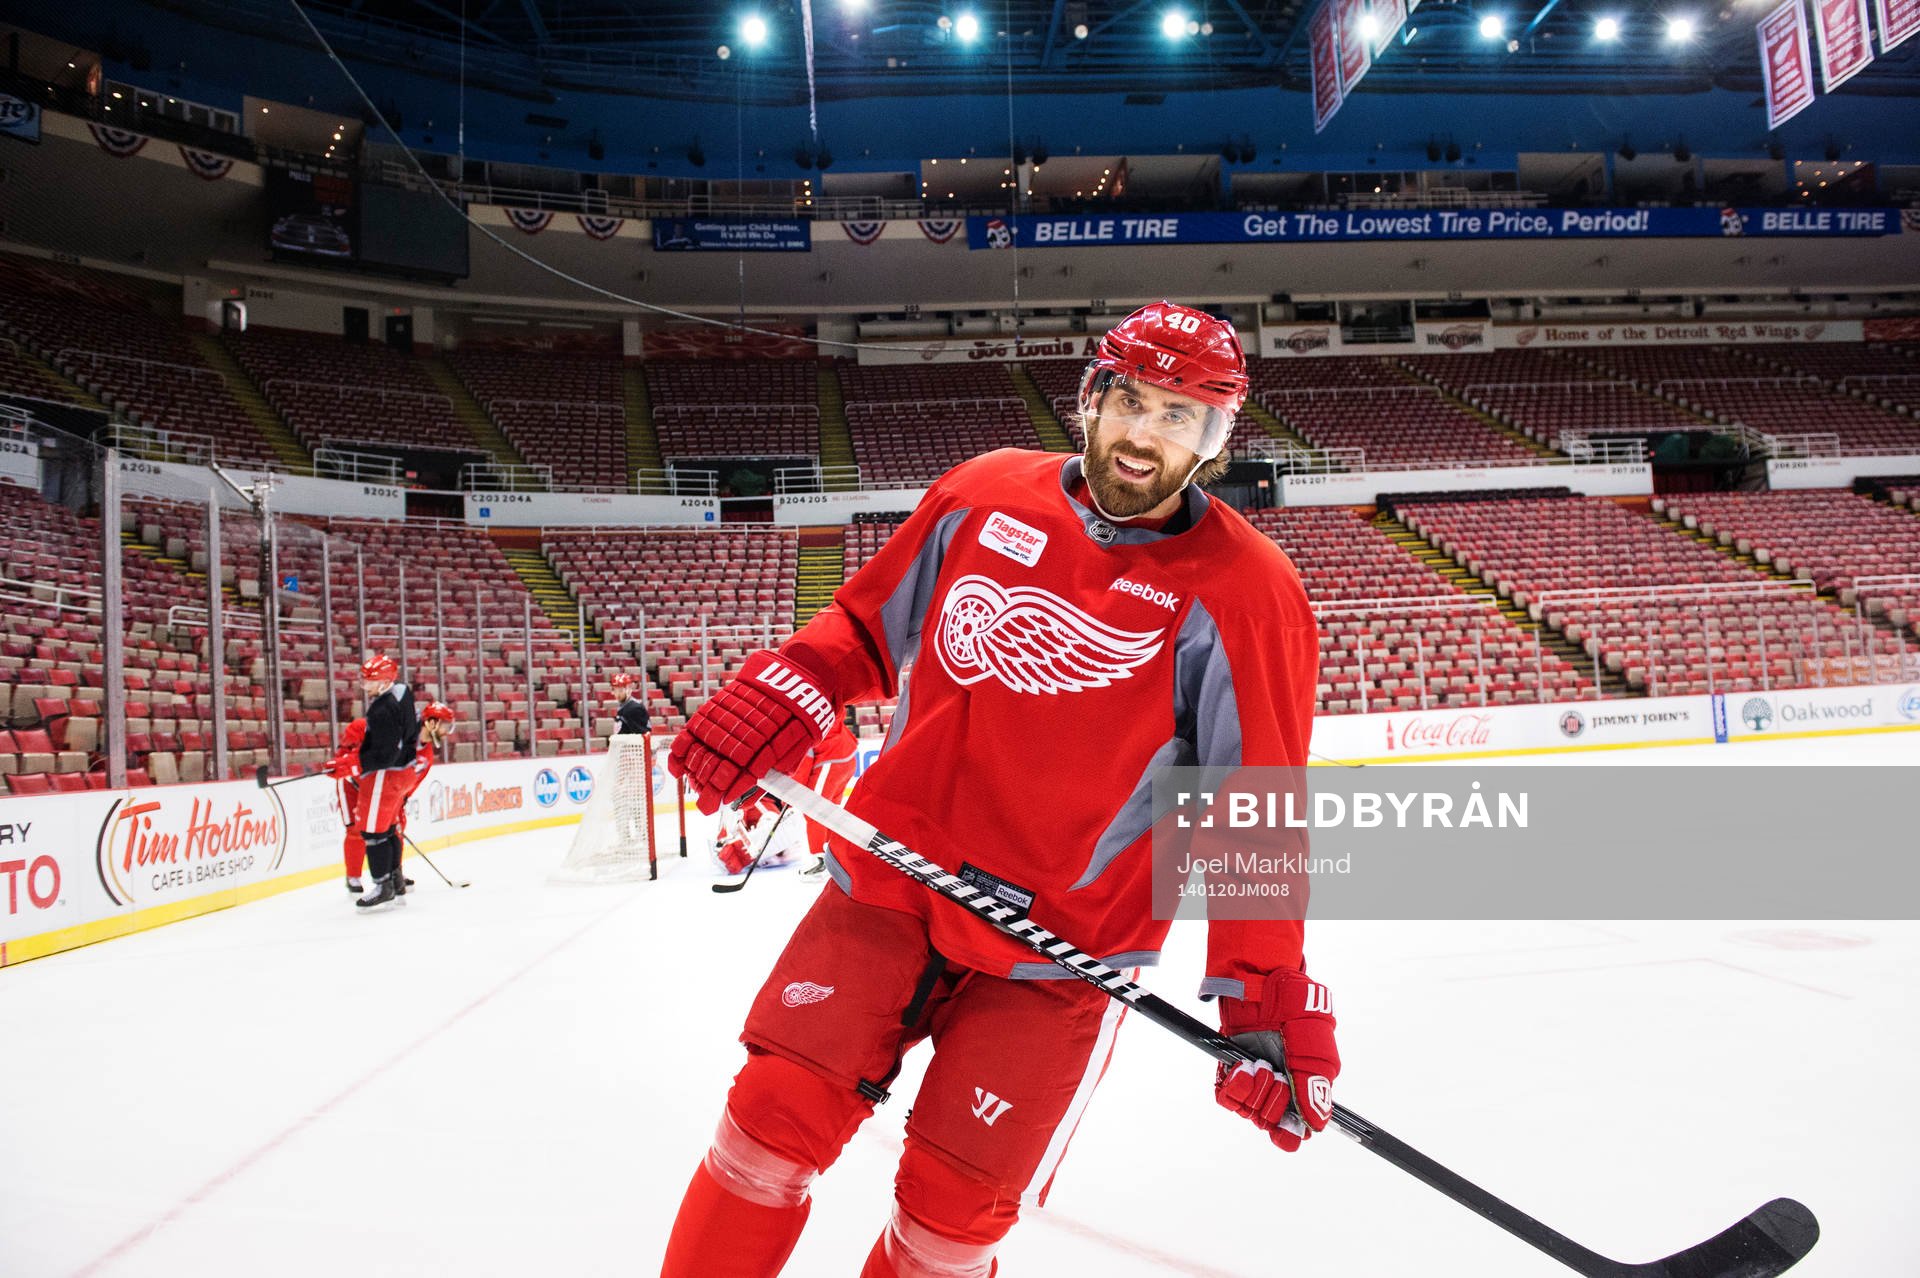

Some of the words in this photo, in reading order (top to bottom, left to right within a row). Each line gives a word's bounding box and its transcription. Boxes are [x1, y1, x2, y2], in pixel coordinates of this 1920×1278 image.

[694, 223, 726, 233] Getting
[728, 224, 748, 232] your
[749, 223, 771, 231] Child
[1035, 220, 1114, 241] BELLE
[1122, 218, 1179, 239] TIRE
[1243, 214, 1287, 236] Get
[1295, 214, 1339, 235] The
[1346, 213, 1432, 234] Lowest
[1439, 212, 1482, 233] Tire
[1488, 211, 1554, 235] Price,
[1562, 211, 1649, 232] Period!
[1762, 212, 1830, 231] BELLE
[1837, 212, 1886, 230] TIRE
[1164, 311, 1201, 334] 40
[1545, 328, 1589, 342] Home
[1598, 328, 1615, 339] of
[1622, 327, 1647, 340] the
[1655, 326, 1710, 340] Detroit
[1716, 326, 1747, 340] Red
[1754, 325, 1801, 341] Wings
[968, 341, 1007, 359] Joe
[1015, 338, 1074, 358] Louis
[1289, 477, 1307, 485] 206
[1309, 476, 1327, 485] 207
[364, 486, 399, 498] B203C
[808, 495, 828, 503] 205
[680, 499, 715, 507] A204B
[991, 517, 1042, 545] Flagstar
[1015, 542, 1033, 554] Bank
[1108, 577, 1181, 613] Reebok
[1591, 711, 1639, 728] JIMMY
[1643, 710, 1691, 725] JOHN'S
[1780, 698, 1873, 721] Oakwood
[445, 784, 473, 819] Little
[475, 783, 523, 815] Caesars
[119, 801, 179, 874] Tim
[184, 796, 278, 862] Hortons
[151, 869, 184, 891] CAFE
[187, 871, 193, 884] &
[196, 861, 225, 882] BAKE
[229, 855, 254, 876] SHOP
[998, 887, 1029, 906] Reebok
[877, 841, 1152, 1003] WARRIOR
